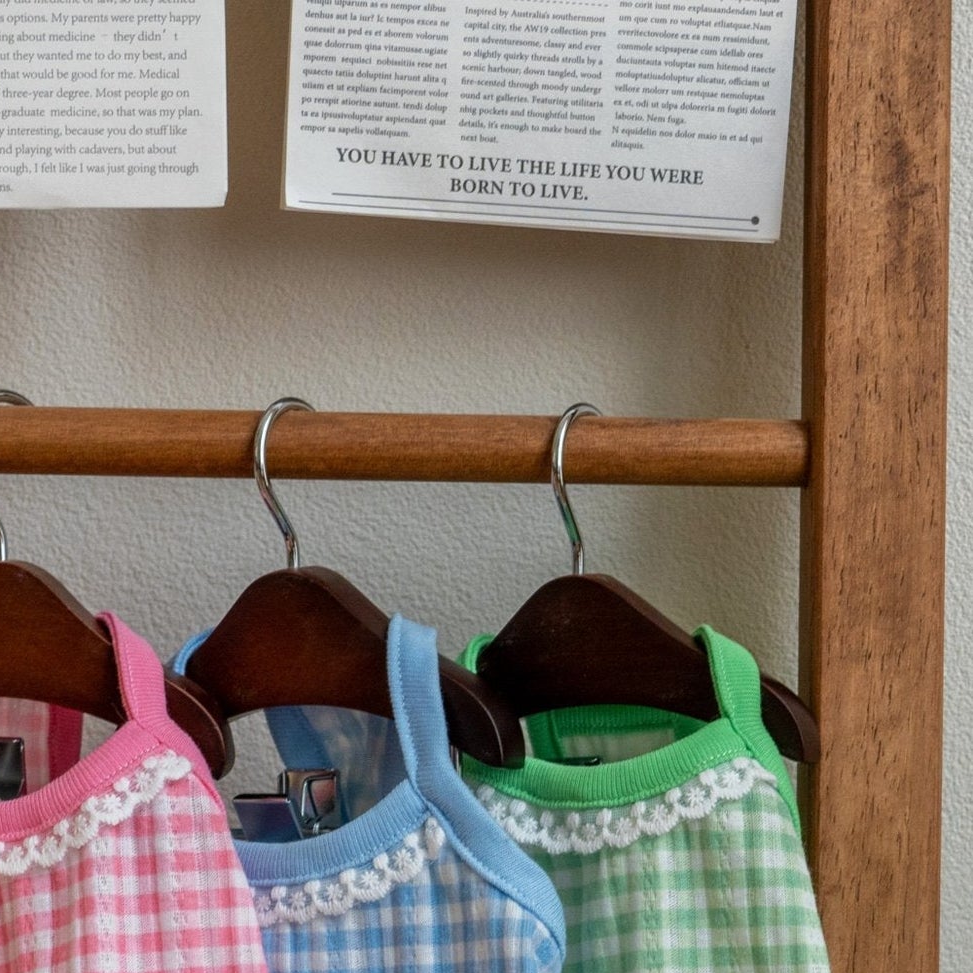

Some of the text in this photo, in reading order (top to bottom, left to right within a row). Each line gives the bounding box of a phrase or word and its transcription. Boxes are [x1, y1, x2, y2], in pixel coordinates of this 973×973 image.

[6, 12, 48, 26] options.
[50, 12, 69, 26] My
[71, 13, 108, 25] parents
[110, 14, 134, 22] were
[136, 13, 167, 26] pretty
[169, 11, 201, 25] happy
[465, 6, 497, 16] Inspired
[499, 7, 509, 18] by
[551, 13, 605, 22] southernmost
[463, 21, 606, 39] capital city, the AW19 collection pres
[0, 68, 20, 79] that
[21, 68, 54, 79] would
[56, 68, 69, 80] be
[70, 68, 98, 82] good
[100, 68, 115, 79] for
[116, 70, 136, 79] me.
[139, 68, 179, 79] Medical
[1, 87, 54, 100] three-year
[55, 87, 92, 101] degree.
[95, 87, 122, 99] Most
[124, 87, 158, 101] people
[160, 89, 174, 101] go
[175, 89, 189, 99] on
[6, 125, 62, 138] interesting,
[64, 124, 105, 136] because
[107, 127, 126, 141] you
[128, 124, 143, 135] do
[145, 124, 169, 136] stuff
[169, 124, 187, 136] like
[479, 134, 498, 143] boat.
[14, 143, 52, 158] playing
[53, 143, 76, 154] with
[78, 143, 125, 156] cadavers,
[127, 143, 145, 154] but
[147, 143, 176, 156] about
[336, 147, 703, 184] YOU HAVE TO LIVE THE LIFE YOU WERE
[450, 178, 588, 200] BORN TO LIVE.
